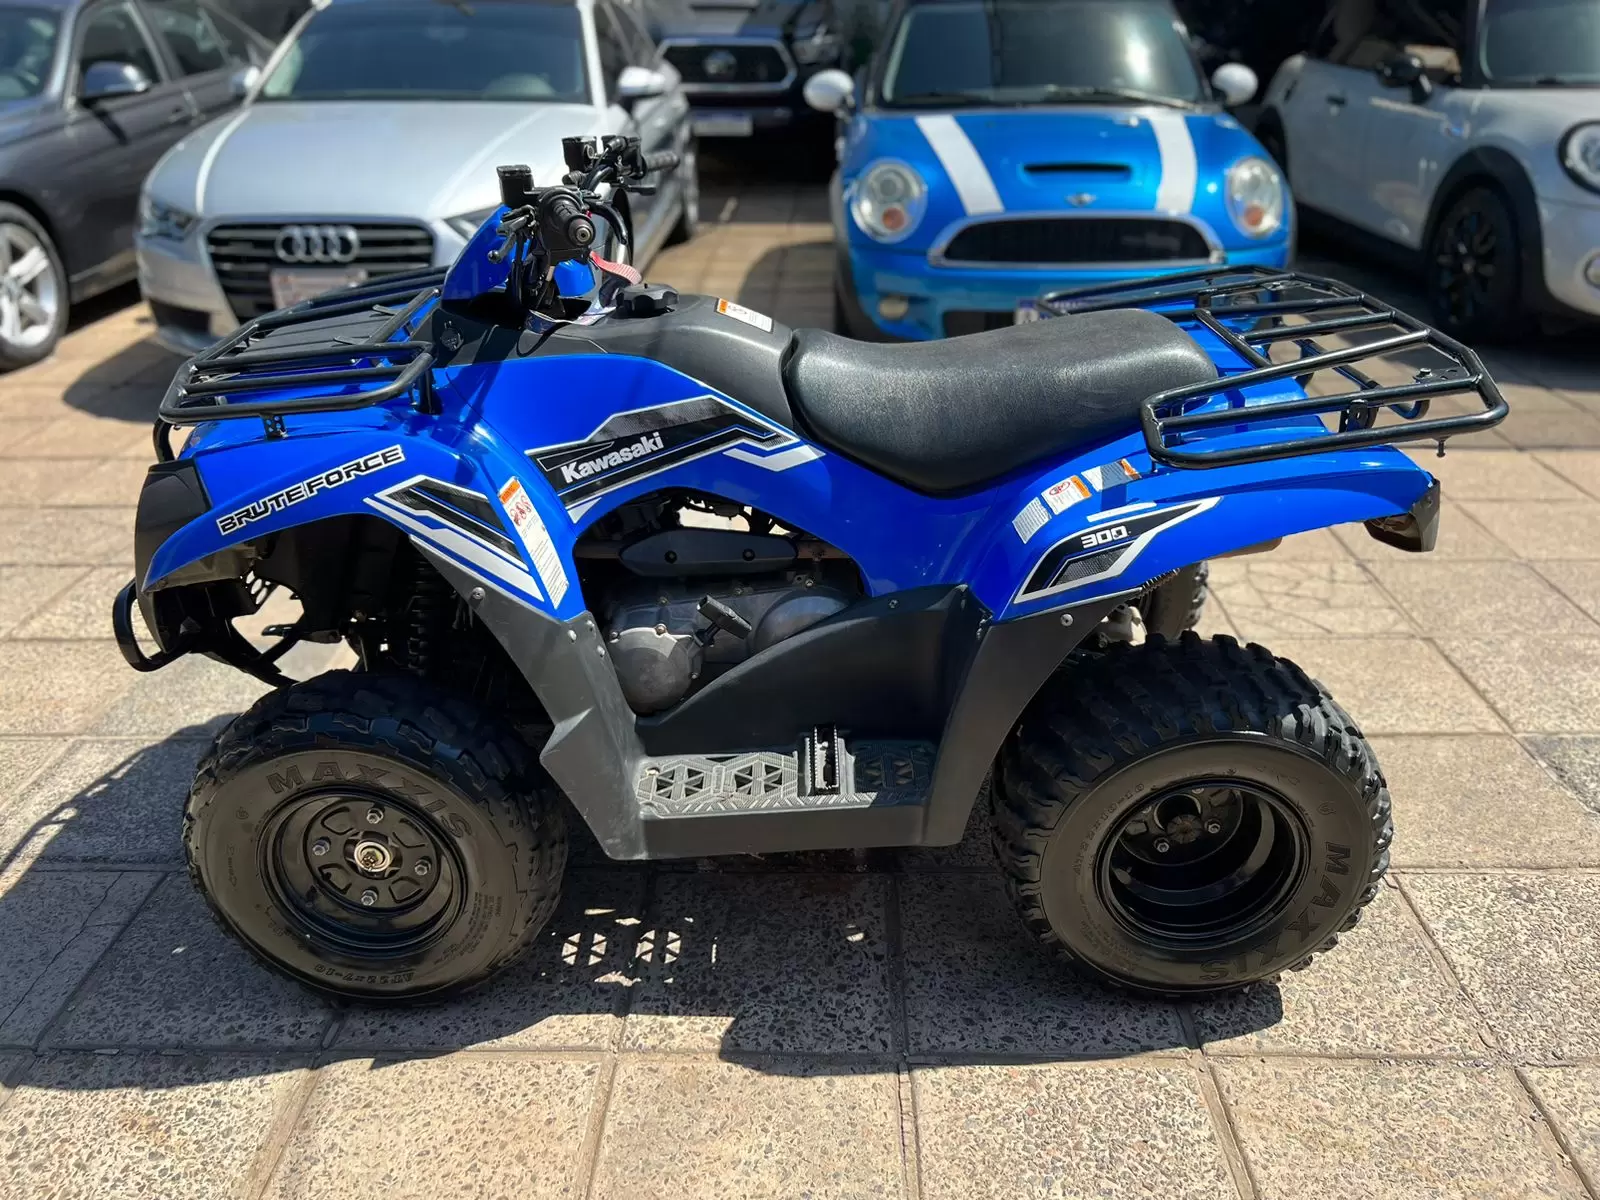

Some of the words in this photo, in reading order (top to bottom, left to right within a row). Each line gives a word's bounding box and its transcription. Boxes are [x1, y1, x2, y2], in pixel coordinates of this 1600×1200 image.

[216, 482, 308, 536] BRUTE
[303, 444, 406, 498] FORCE
[560, 432, 664, 483] Kawasaki
[1081, 525, 1128, 549] 300
[265, 761, 473, 838] MAXXIS
[1200, 841, 1351, 980] MAXXIS
